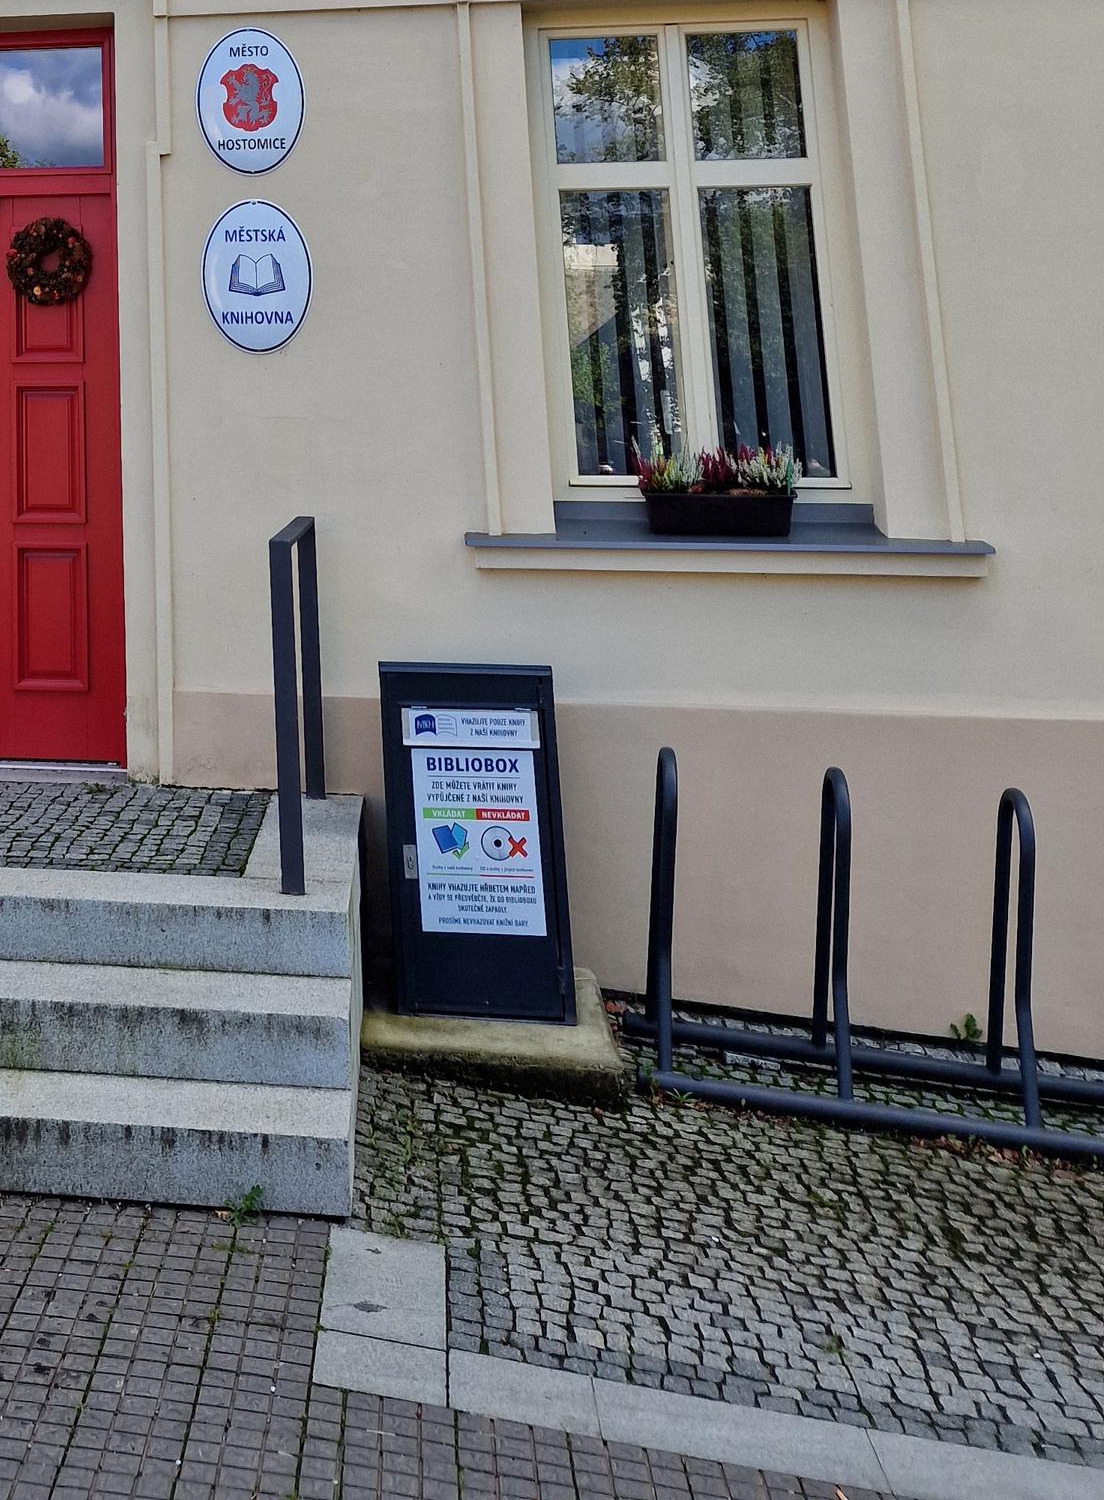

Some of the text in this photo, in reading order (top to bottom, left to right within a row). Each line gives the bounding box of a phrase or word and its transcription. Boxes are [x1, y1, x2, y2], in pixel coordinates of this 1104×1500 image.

[229, 43, 269, 58] MĚSTO
[218, 138, 287, 151] HOSTOMICE
[224, 225, 286, 243] MĚSTSKÁ
[222, 310, 294, 325] KNIHOVNA
[460, 717, 526, 727] VHAZUJTE POUZE KNIHY
[475, 728, 488, 736] NAŠÍ
[489, 729, 517, 737] KNIHOVNY
[426, 756, 519, 773] BIBLIOBOX
[431, 779, 518, 791] ZDE MŮŽETE VRÁTIT KNIHY
[427, 791, 524, 804] VYPŮJČENÉ Z NAŠÍ KNIHOVNY
[432, 808, 466, 818] VKLÁDAT
[481, 809, 526, 820] NEVKLÁDAT
[427, 882, 536, 894] KNIHY VHAZUJTE HŘBETEM NAPŘED
